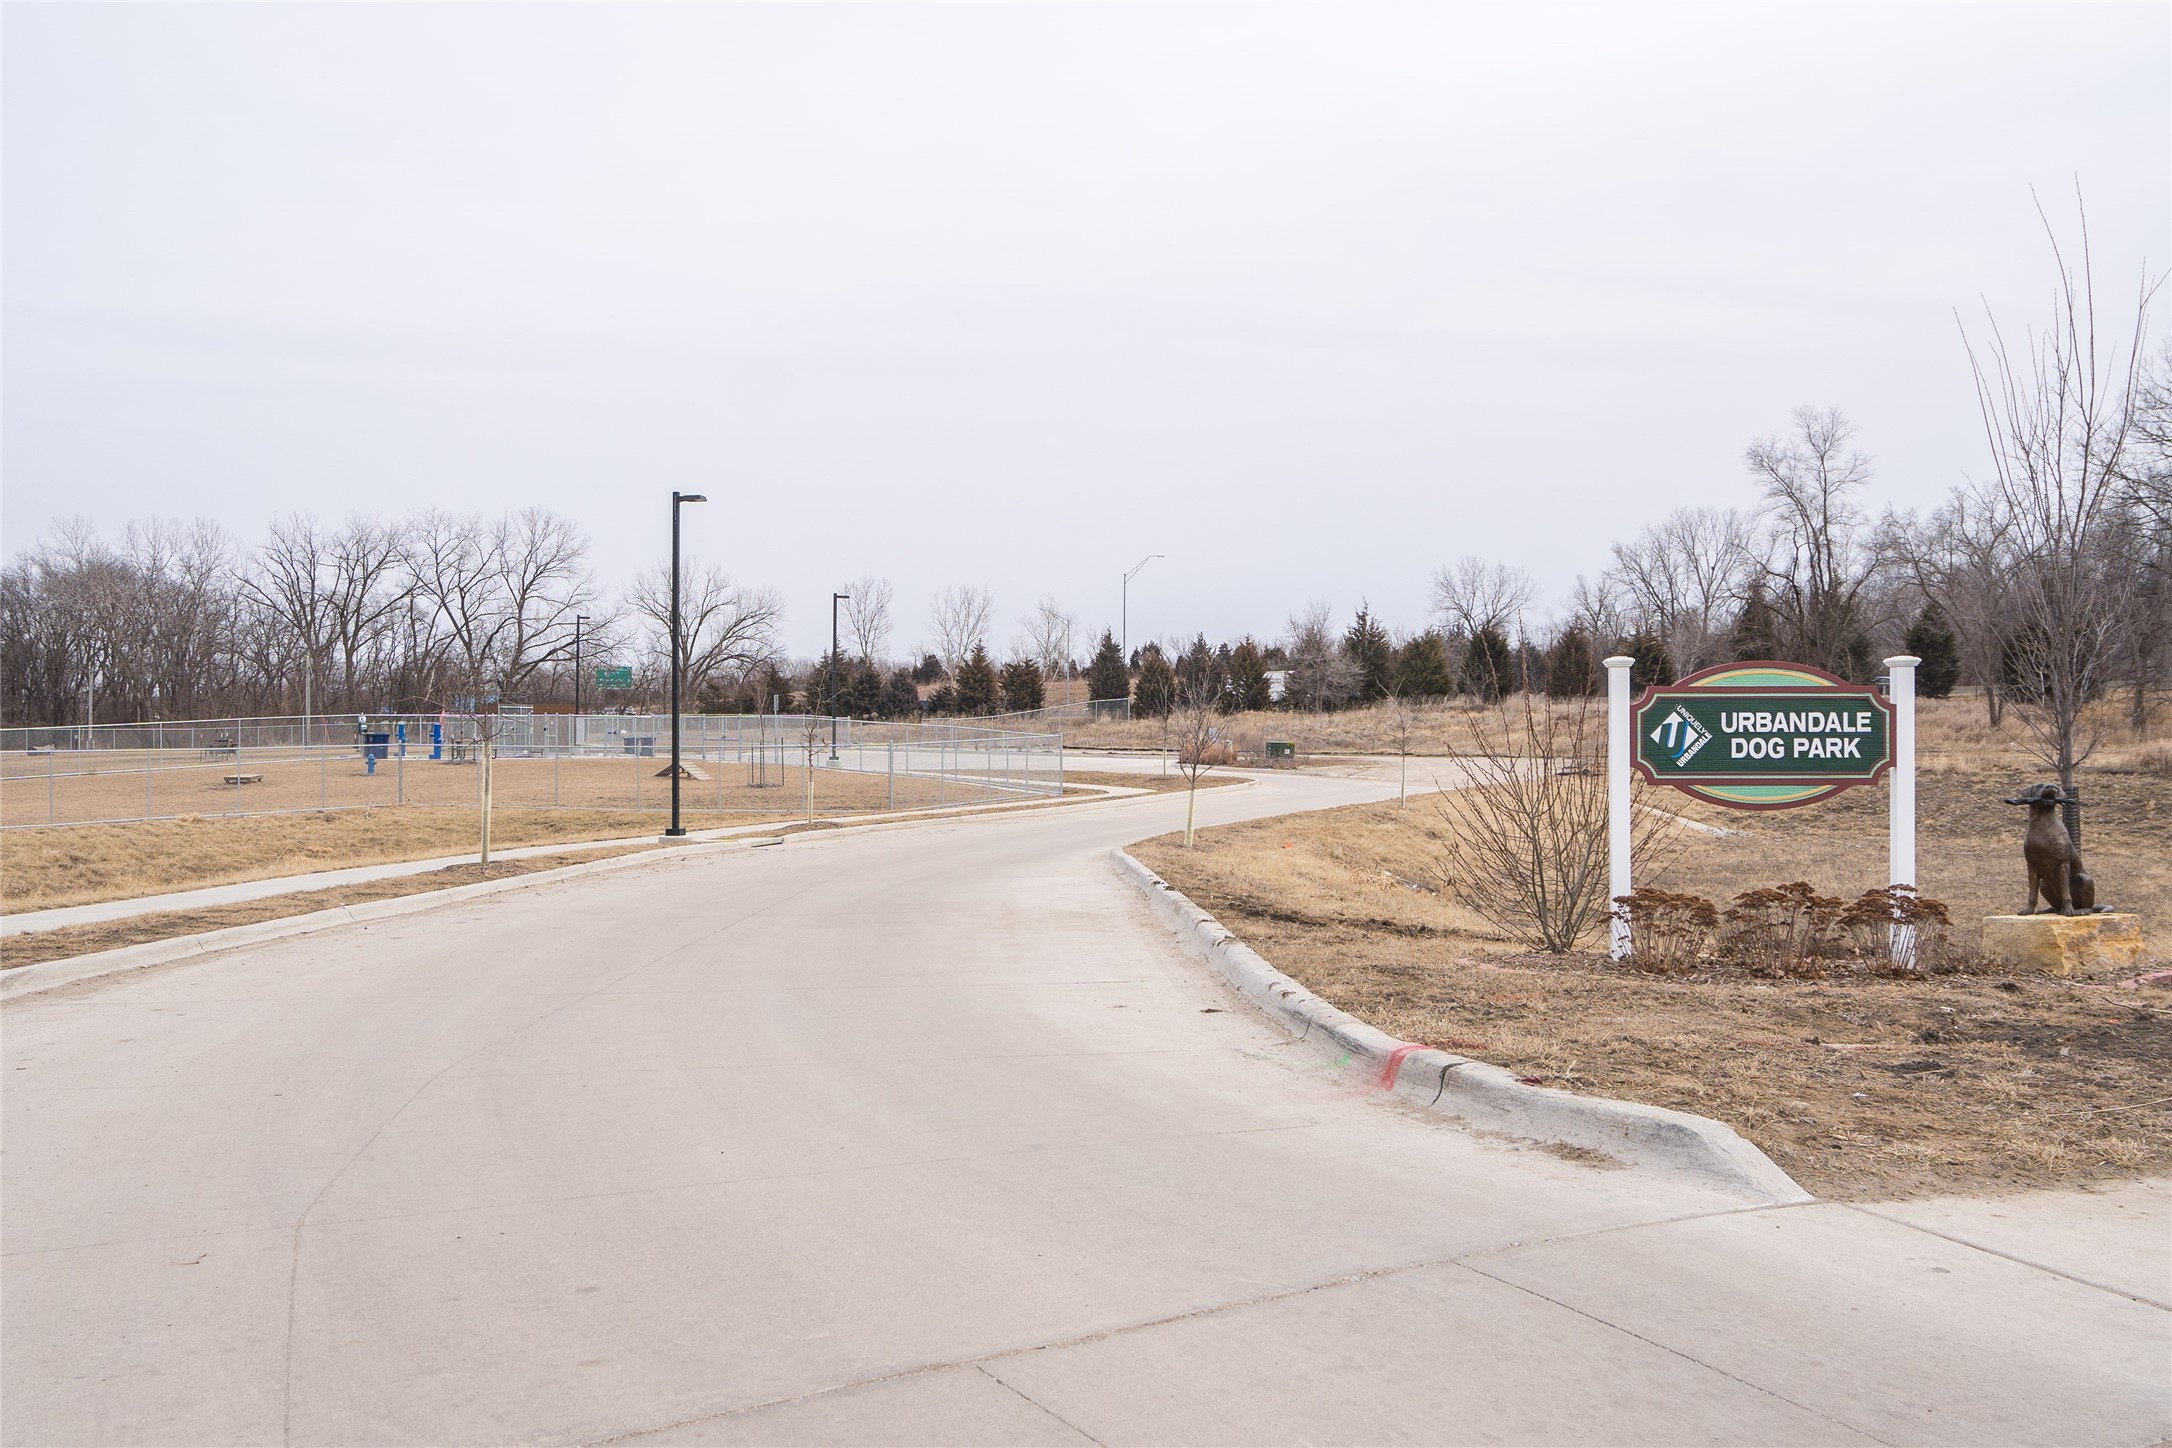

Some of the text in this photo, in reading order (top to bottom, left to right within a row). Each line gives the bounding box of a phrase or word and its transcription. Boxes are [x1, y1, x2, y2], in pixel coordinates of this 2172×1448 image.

[1676, 704, 1707, 734] UNIQUELY
[1720, 712, 1872, 733] URBANDALE
[1676, 731, 1713, 767] URBANDALE
[1731, 737, 1862, 759] DOG PARK
